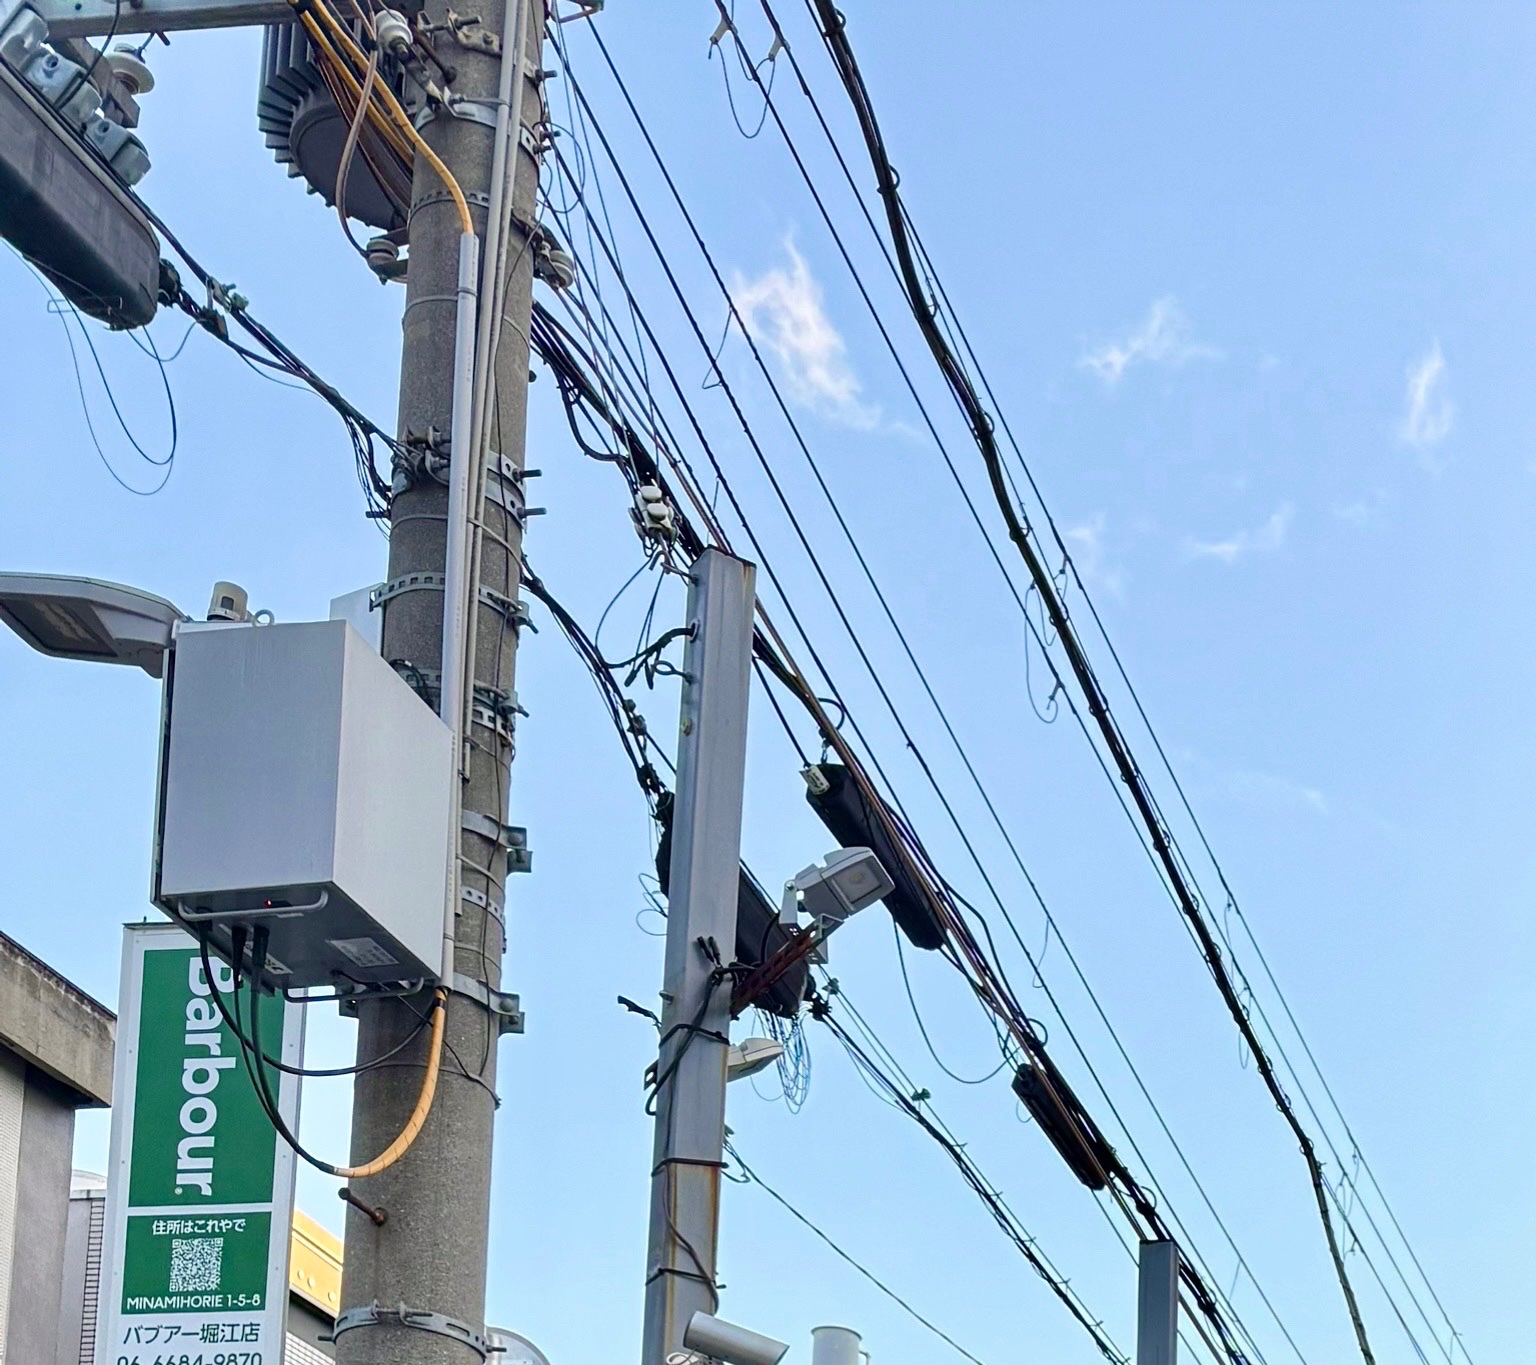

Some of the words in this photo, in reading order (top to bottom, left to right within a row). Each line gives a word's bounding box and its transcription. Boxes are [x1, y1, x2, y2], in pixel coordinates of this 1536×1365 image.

[176, 956, 236, 1196] Barbour
[152, 1218, 247, 1235] 住所はこれやで
[127, 1295, 222, 1309] MINAMIHORIE
[227, 1294, 260, 1306] 1-5-8
[123, 1322, 260, 1344] バブアー堀江店
